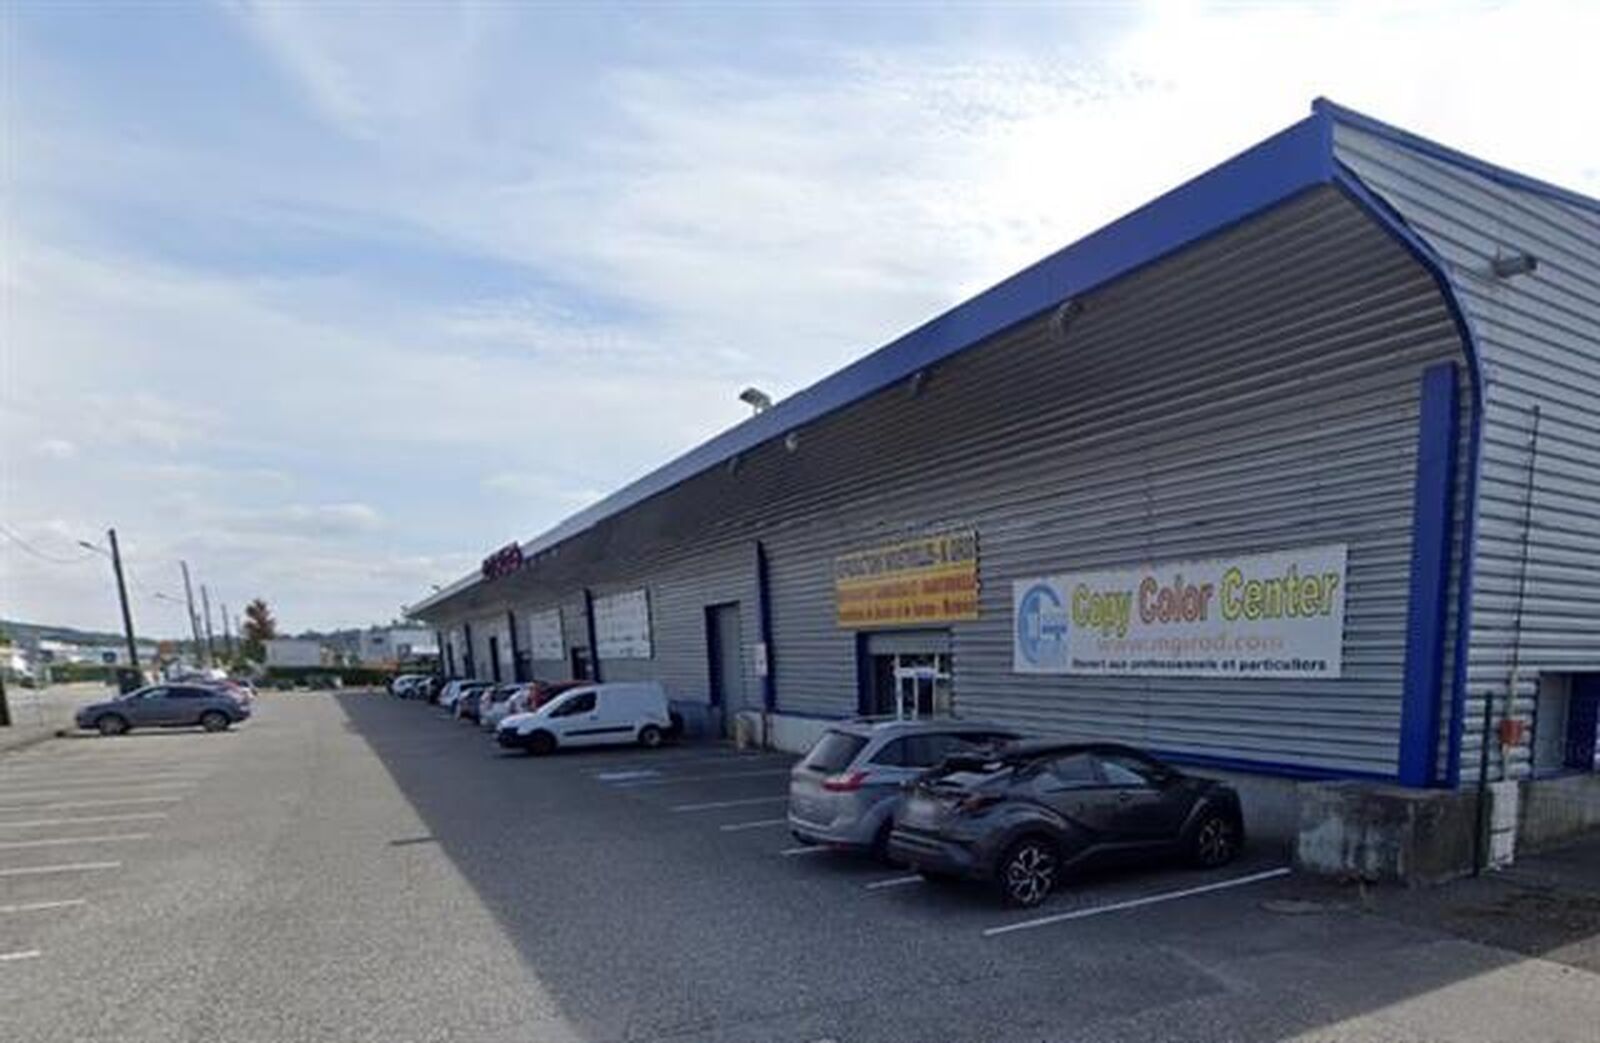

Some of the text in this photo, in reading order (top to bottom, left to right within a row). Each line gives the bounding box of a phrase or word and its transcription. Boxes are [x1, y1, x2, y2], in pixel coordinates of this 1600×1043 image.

[1071, 583, 1133, 638] Copy
[1139, 575, 1214, 625] Color
[1220, 563, 1339, 622] Center
[1221, 659, 1236, 671] et
[1239, 658, 1327, 673] particuliers
